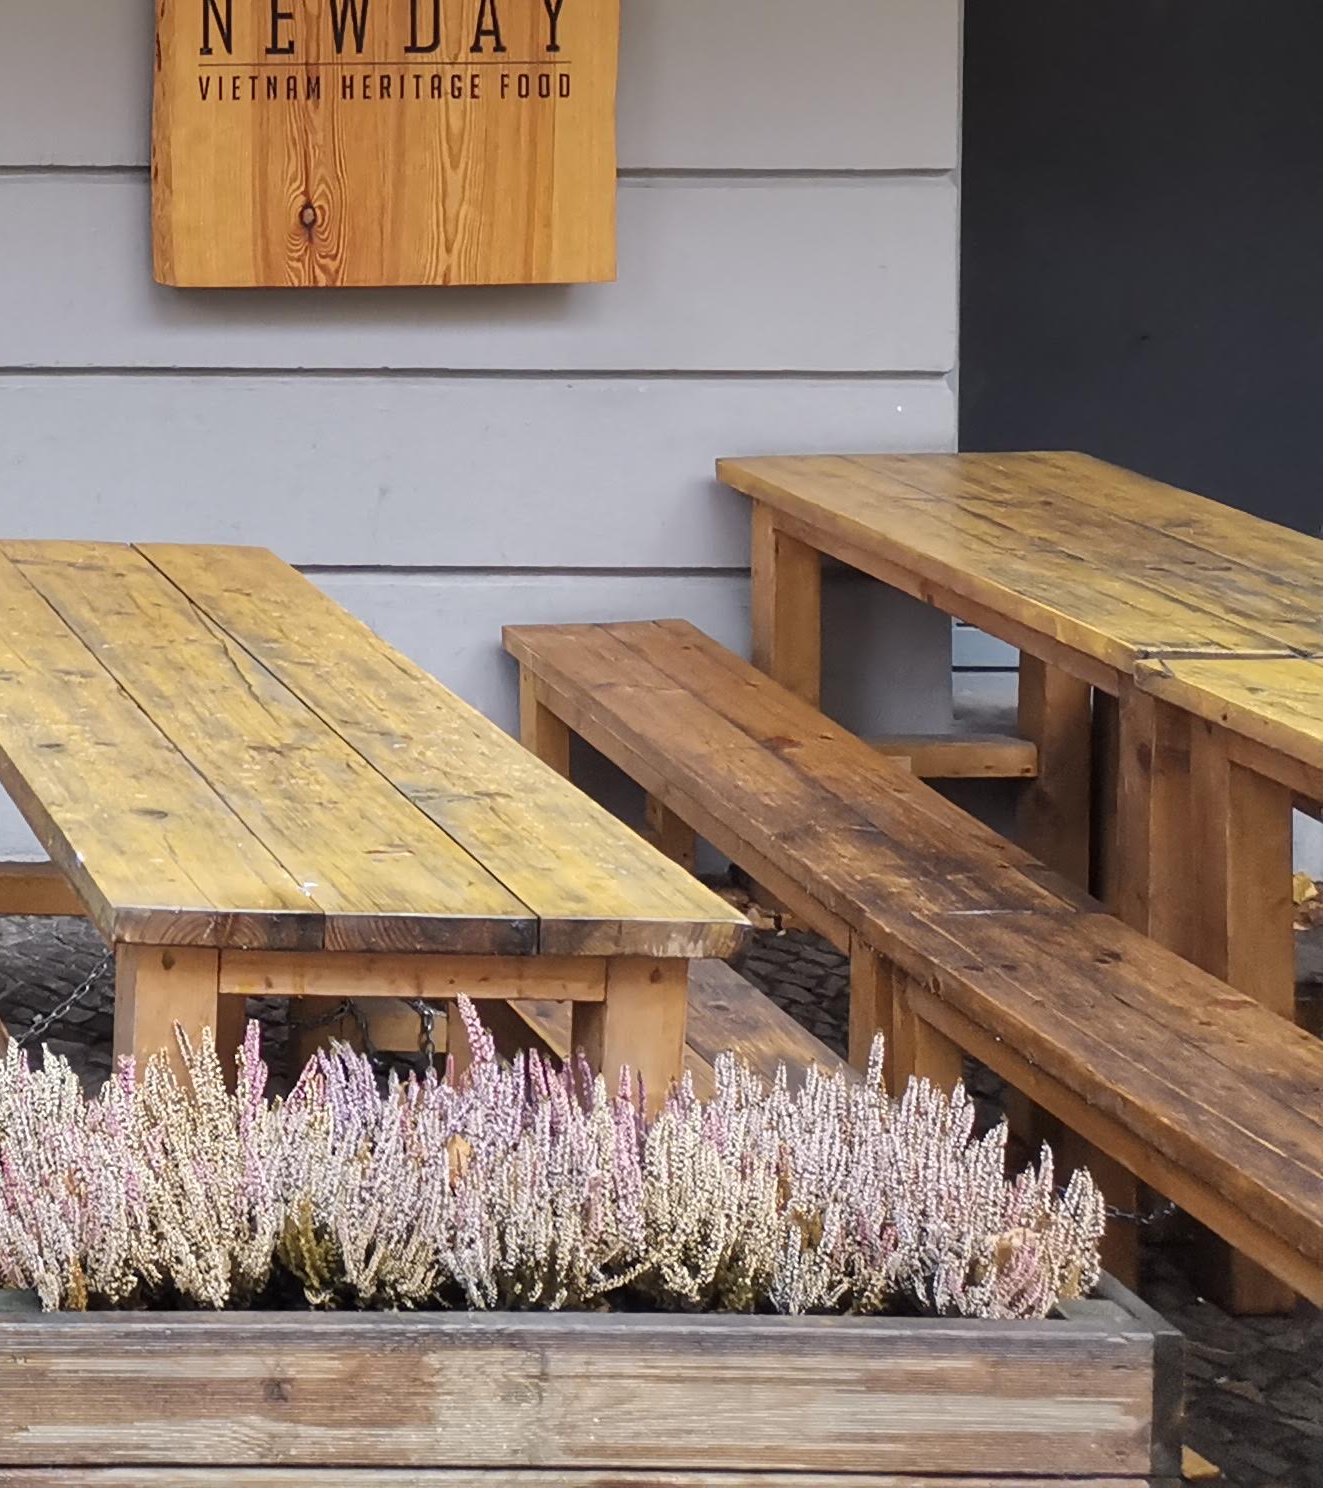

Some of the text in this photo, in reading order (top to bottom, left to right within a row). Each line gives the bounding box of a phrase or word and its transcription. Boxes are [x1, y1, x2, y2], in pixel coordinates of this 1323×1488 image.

[199, 74, 572, 101] VIETNAM HERITAGE FOOD
